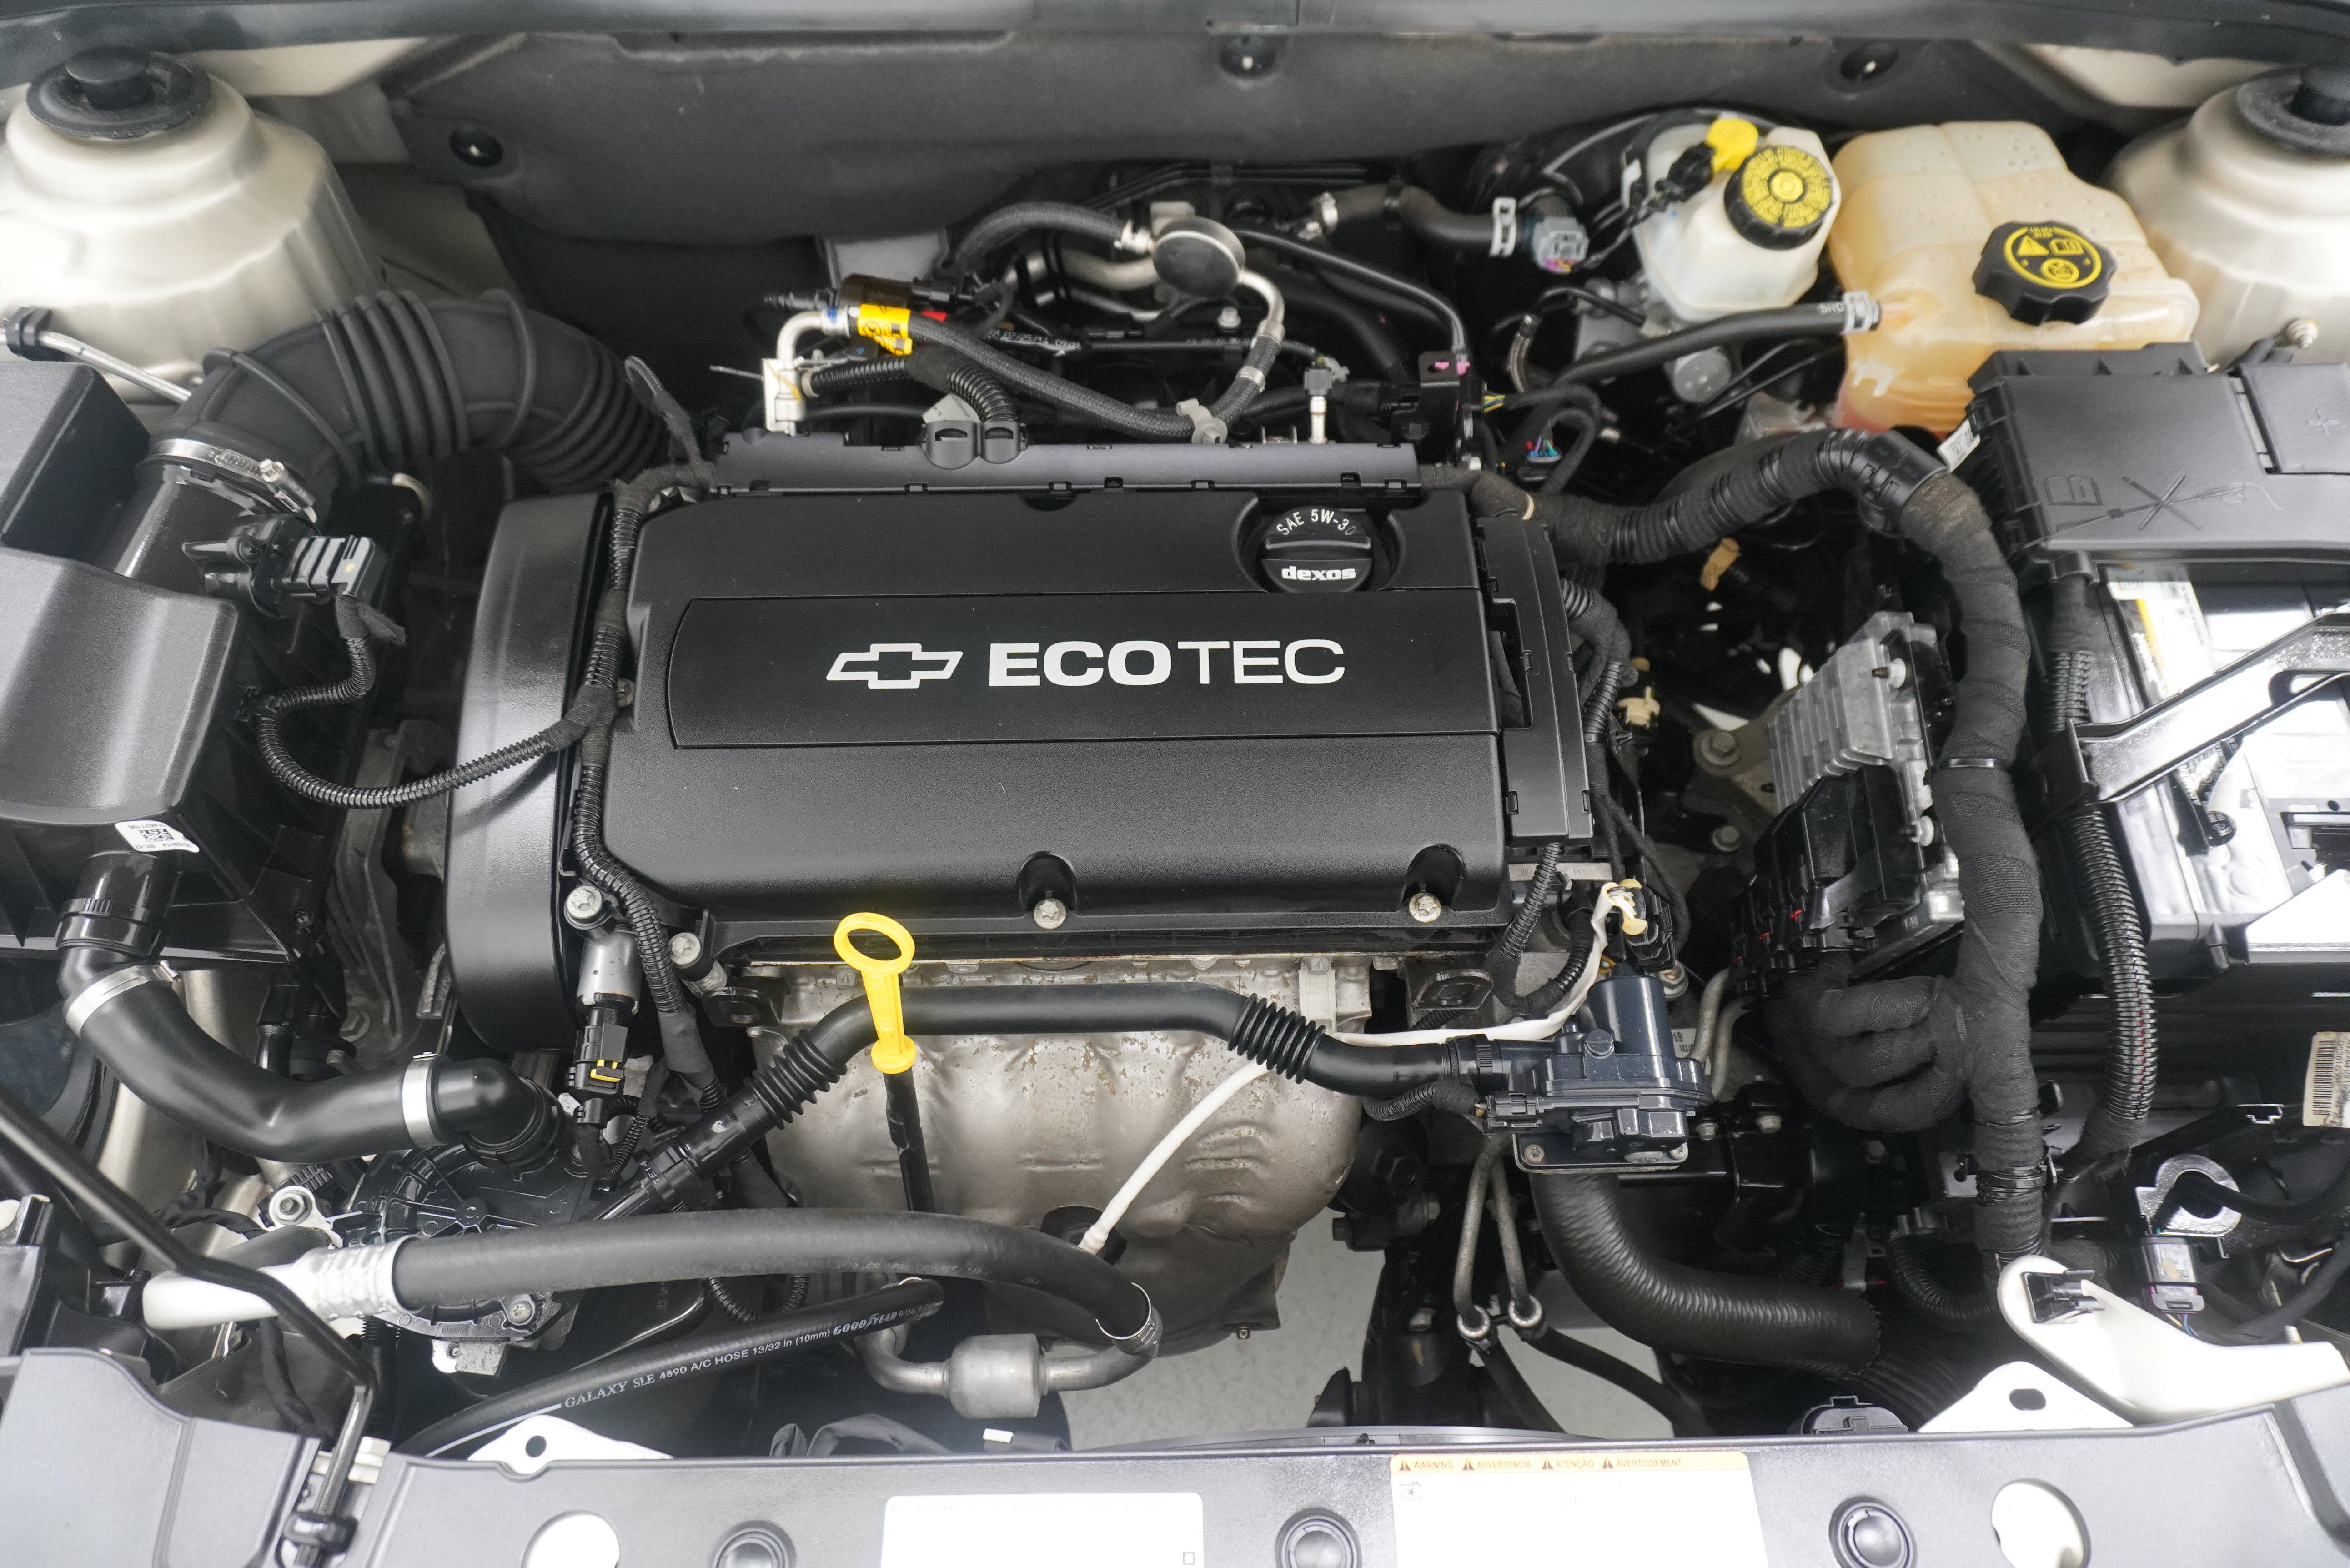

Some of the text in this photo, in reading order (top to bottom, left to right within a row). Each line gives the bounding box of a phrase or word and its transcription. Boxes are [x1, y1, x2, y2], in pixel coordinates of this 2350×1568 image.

[1276, 509, 1357, 535] SAE 5W-30
[1281, 566, 1356, 581] dexos
[989, 639, 1346, 687] ECOTEC
[565, 1380, 629, 1408] GALAXY
[633, 1373, 656, 1388] SLE
[659, 1366, 688, 1380] 4890
[690, 1359, 712, 1372] A/C
[714, 1349, 749, 1366] HOSE
[752, 1341, 781, 1356] 13/32
[783, 1339, 793, 1348] in
[795, 1328, 830, 1346] (10mm)
[1413, 1460, 1454, 1470] WARNING
[1477, 1460, 1532, 1469] ADVERTENCIA
[1556, 1458, 1594, 1470] ATENÇÃO
[1617, 1458, 1682, 1467] AVERTISSEMENT
